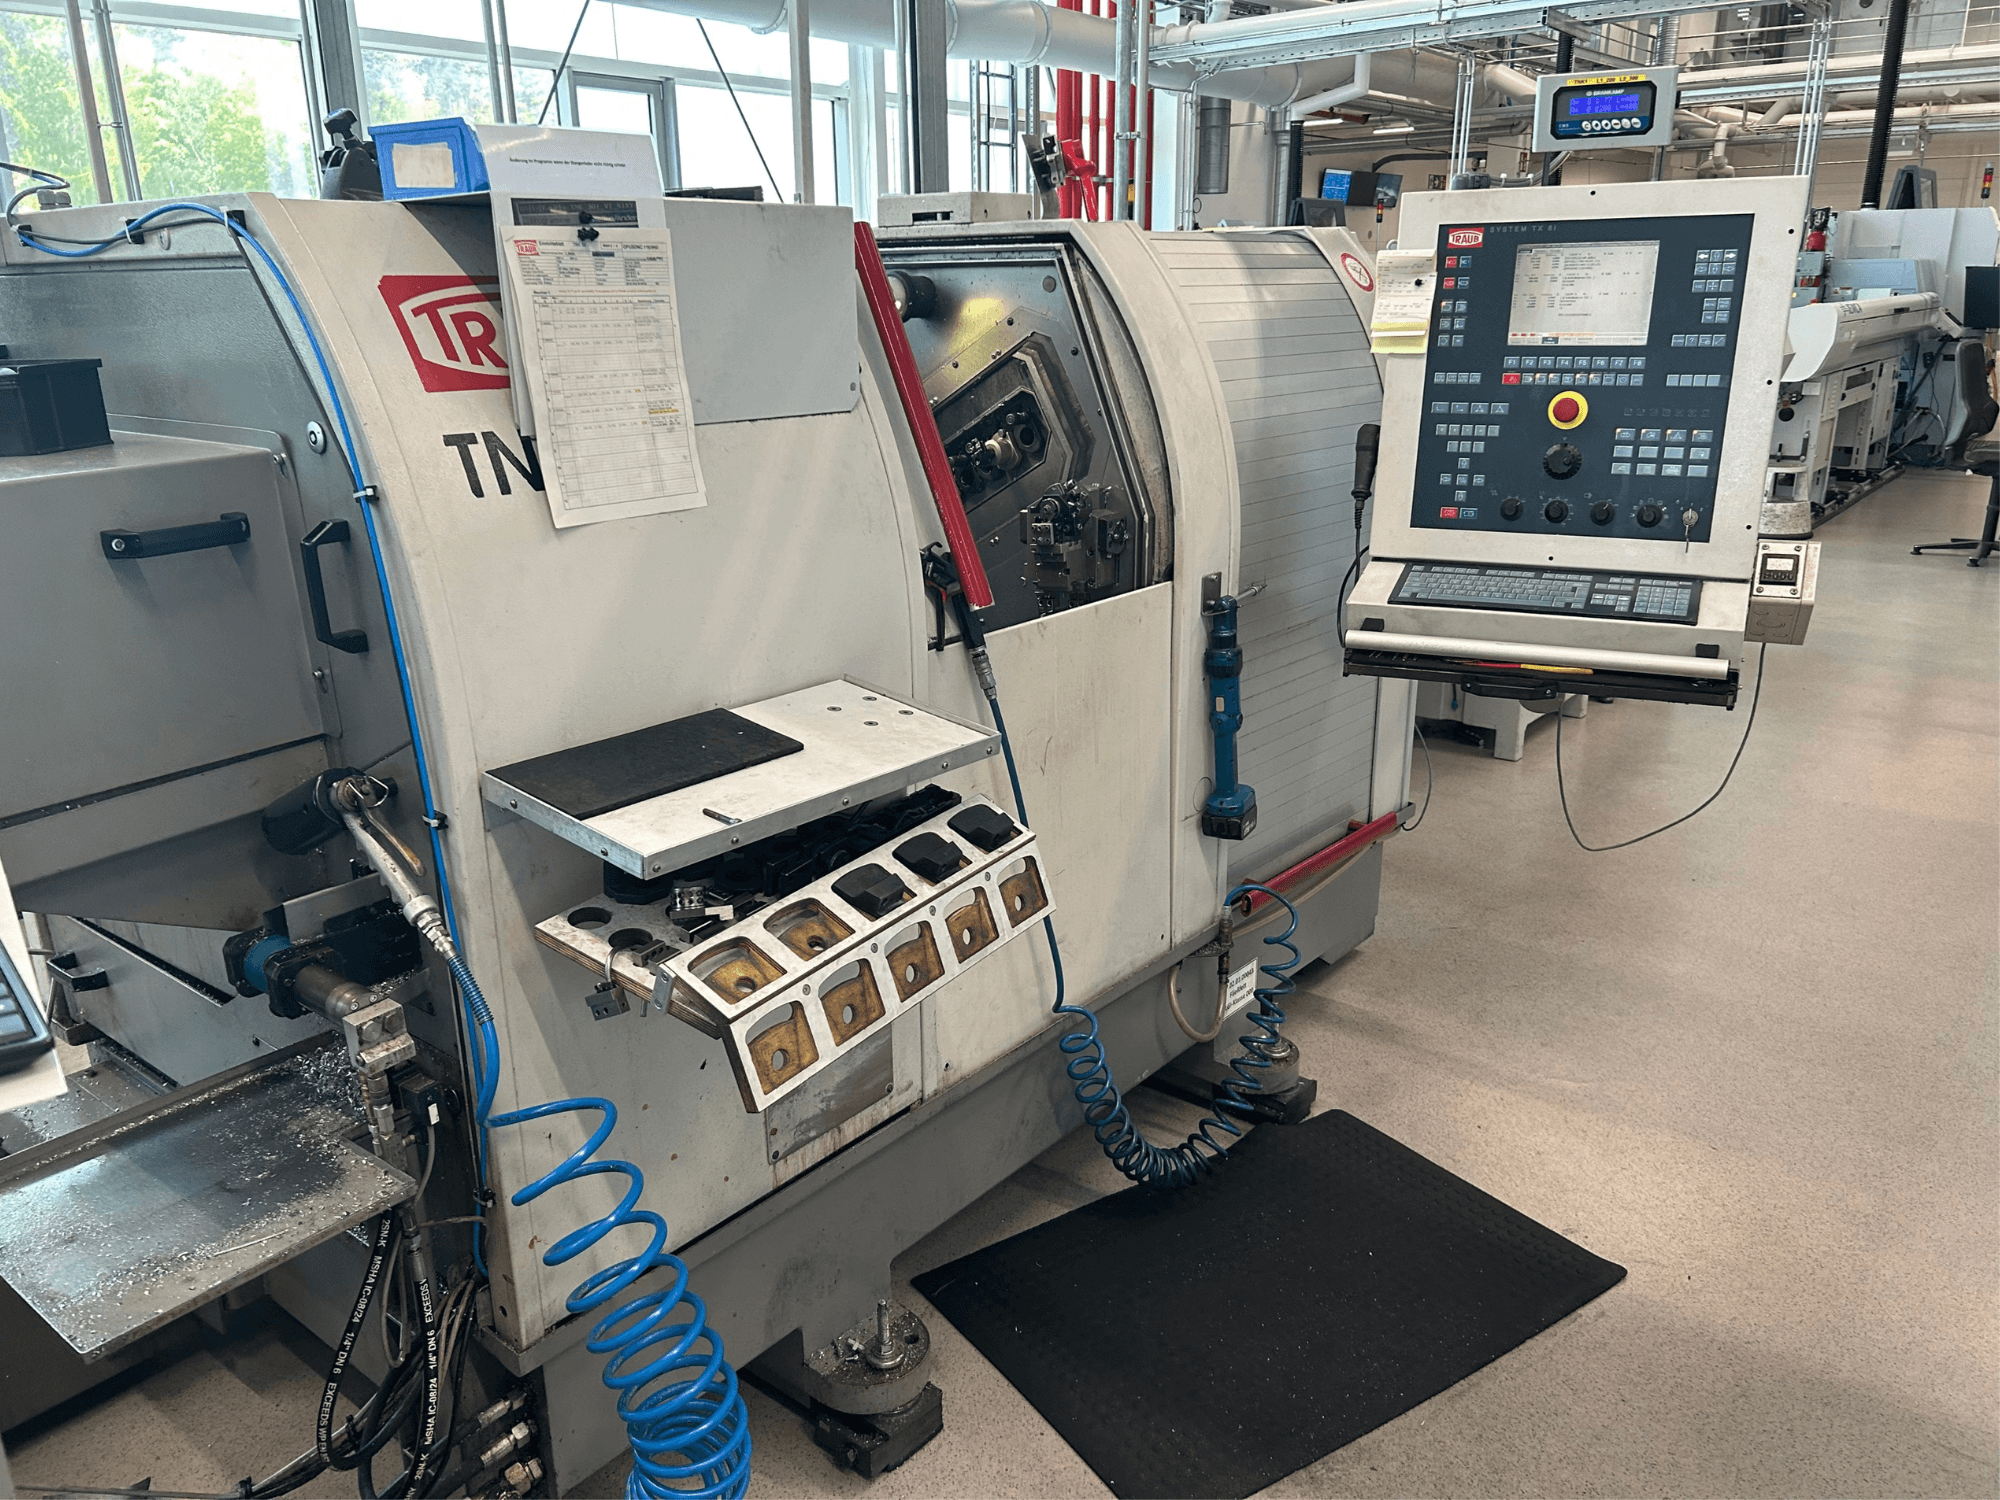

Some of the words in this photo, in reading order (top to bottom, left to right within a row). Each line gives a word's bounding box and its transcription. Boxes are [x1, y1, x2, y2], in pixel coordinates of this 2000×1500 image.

[1451, 231, 1480, 244] TRAUB
[411, 292, 509, 368] TR
[443, 431, 546, 498] TN
[377, 1219, 391, 1247] 2SN-K
[366, 1255, 383, 1284] MSHA
[352, 1284, 373, 1323] IC-08/24
[420, 1283, 434, 1323] EXCEEDS
[343, 1332, 355, 1350] 1/4"
[427, 1336, 437, 1351] DN
[335, 1351, 348, 1367] DN
[319, 1382, 338, 1427] EXCEEDS
[428, 1377, 438, 1415] IC-08/24
[318, 1427, 328, 1441] WP
[424, 1415, 436, 1445] MSHA
[414, 1453, 430, 1481] 2SN-K
